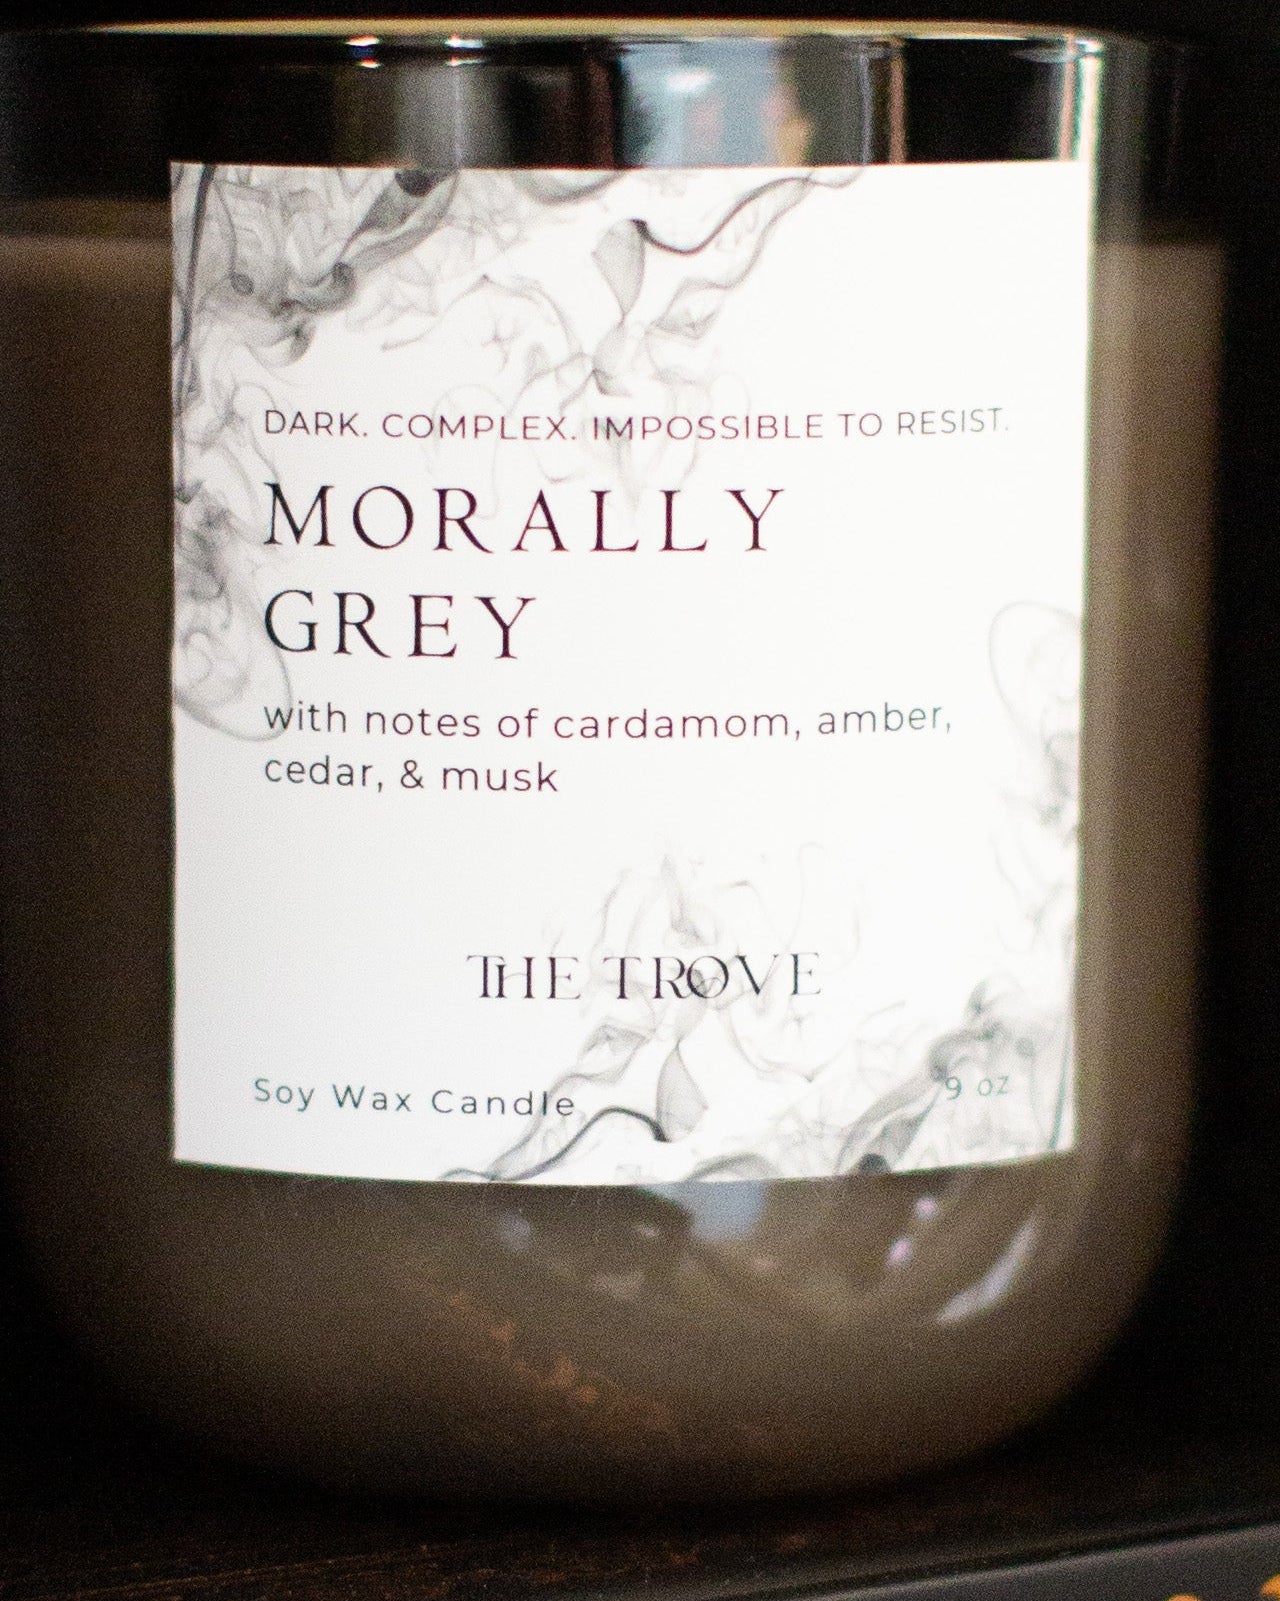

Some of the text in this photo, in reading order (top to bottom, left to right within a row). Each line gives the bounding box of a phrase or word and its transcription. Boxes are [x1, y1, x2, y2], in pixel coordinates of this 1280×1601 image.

[264, 406, 1010, 442] DARK. COMPLEX. IMPOSSIBLE TO RESIST.
[264, 483, 785, 553] MORALLY
[264, 590, 536, 661] GREY
[264, 702, 952, 745] with notes of cardamom, amber,
[264, 756, 559, 794] cedar, & musk
[468, 952, 821, 1001] THE TROVE
[254, 1079, 576, 1119] Soy Wax Candle
[944, 1076, 1010, 1102] 9 oz
